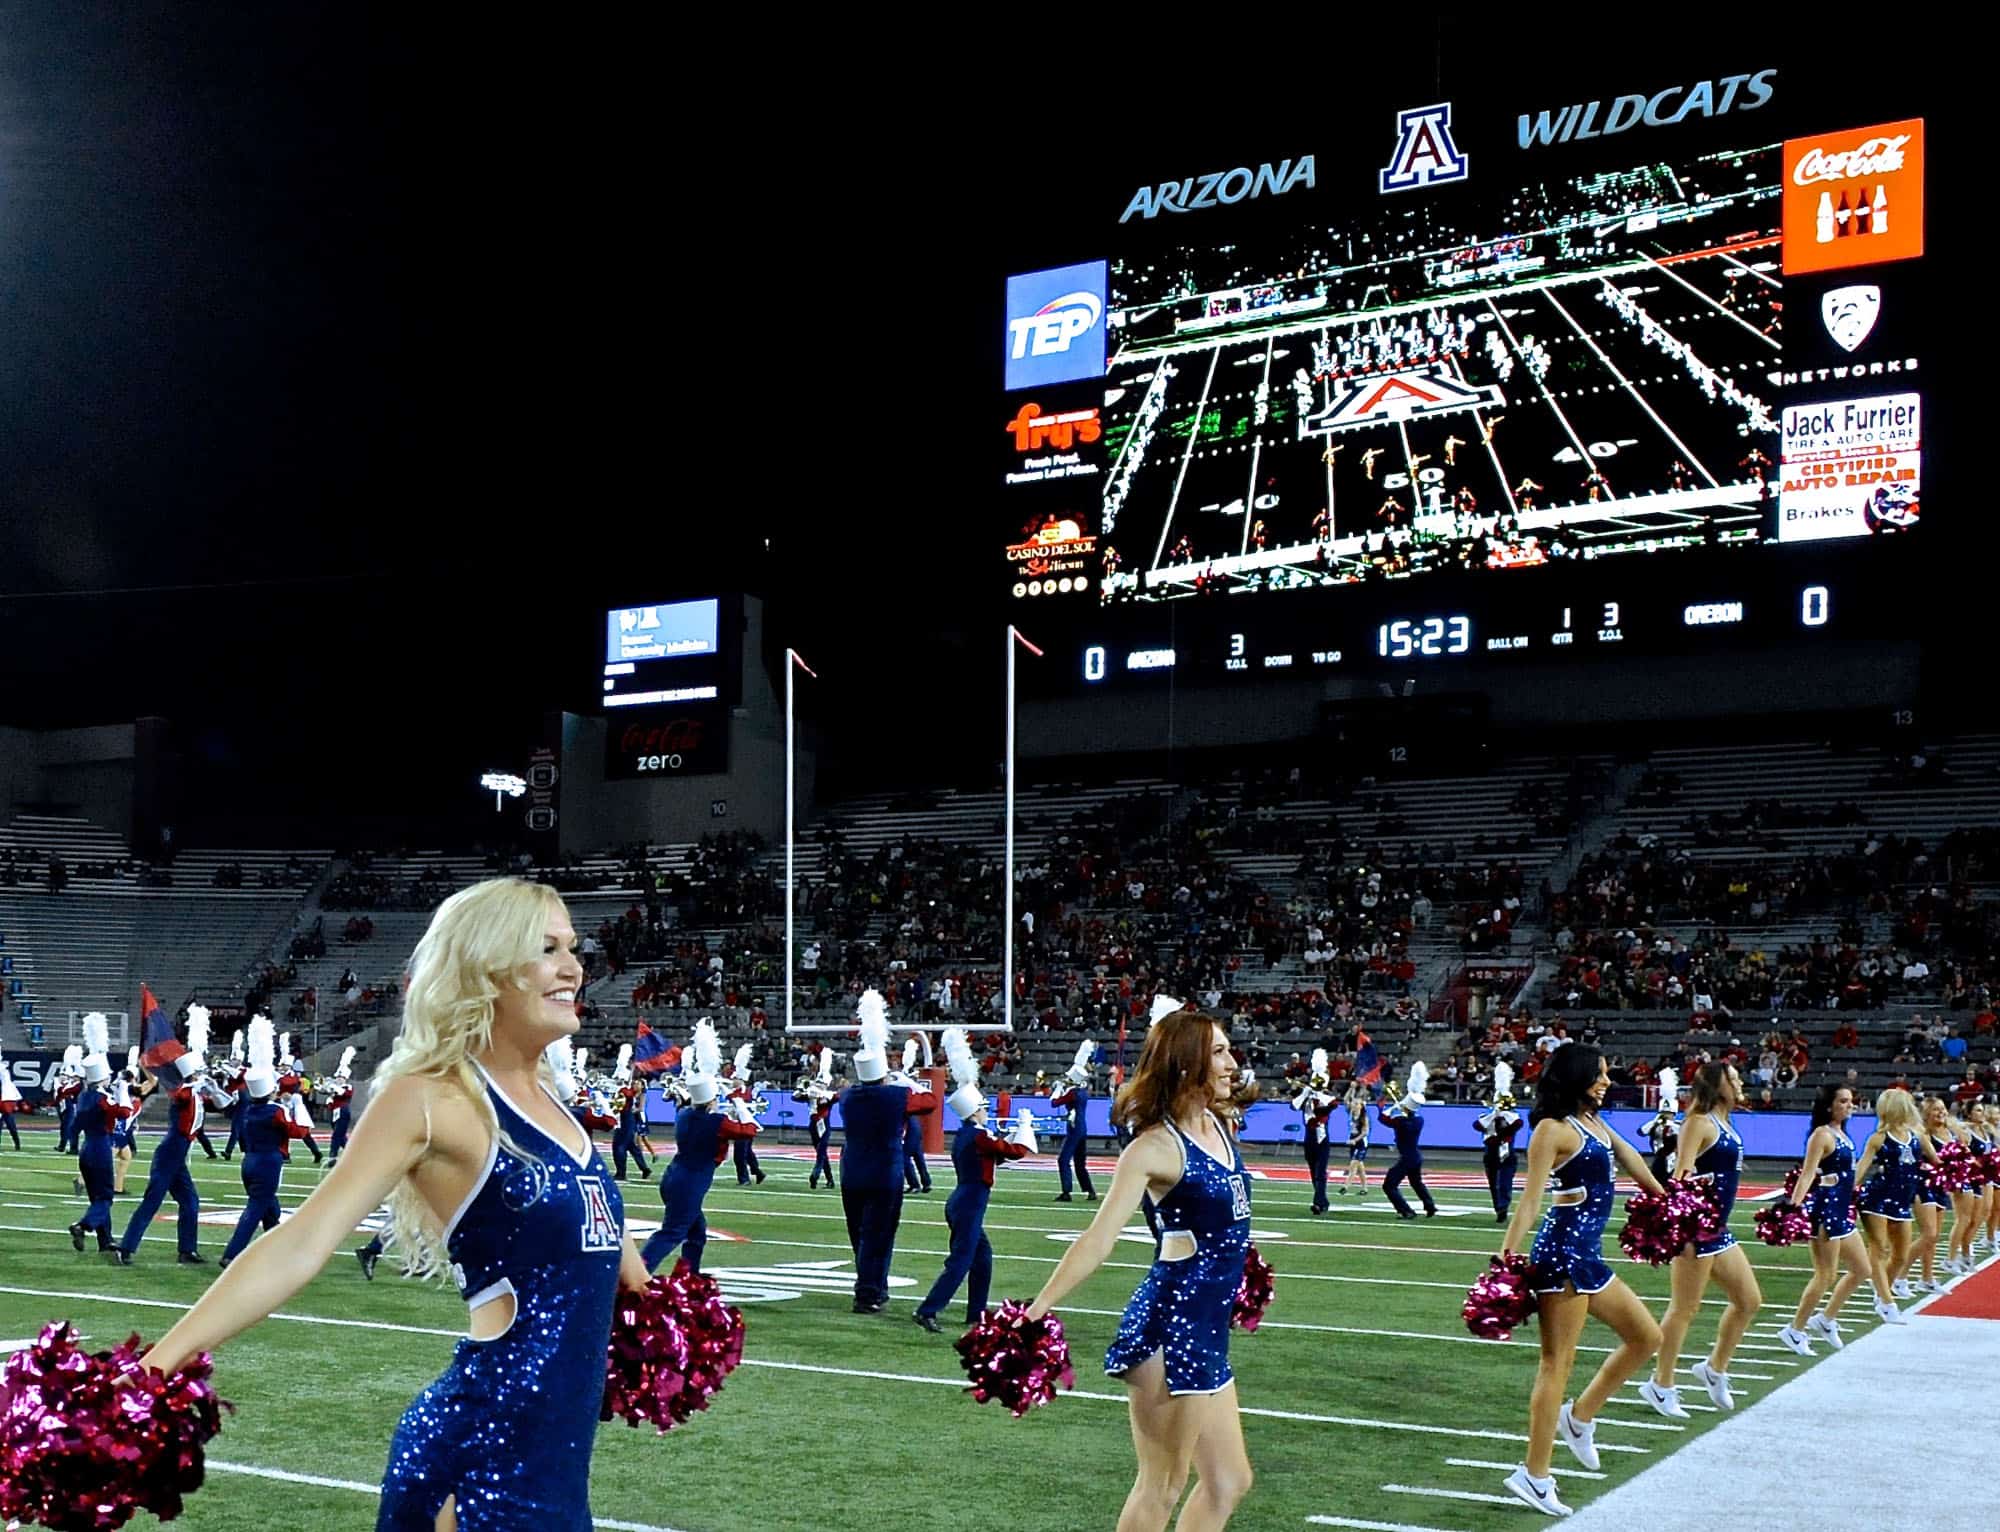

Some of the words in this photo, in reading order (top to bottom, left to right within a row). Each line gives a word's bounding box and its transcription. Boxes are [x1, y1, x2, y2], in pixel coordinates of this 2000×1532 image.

[1518, 68, 1778, 149] WILDCATS
[1379, 102, 1469, 195] A
[1118, 154, 1315, 224] ARIZONA
[1009, 308, 1093, 360] TEP
[1783, 358, 1919, 386] NETWORKS
[1786, 408, 1835, 438] Jack
[1845, 400, 1916, 431] Furrier
[1837, 432, 1874, 445] AUTO
[1801, 457, 1898, 477] CERTIFIED
[1783, 476, 1838, 492] AUTO
[1845, 468, 1916, 486] REPAIR
[1786, 506, 1855, 521] Brakes
[1007, 546, 1050, 561] CASINO
[1051, 545, 1072, 556] DEL
[1073, 542, 1096, 553] SOL
[1604, 602, 1619, 626] 3
[1802, 586, 1828, 625] 0
[1563, 607, 1571, 628] 1
[1231, 634, 1244, 656] 3
[1379, 616, 1470, 657] 15:23
[1487, 638, 1512, 649] BALL
[1085, 647, 1104, 680] 0
[1264, 655, 1292, 667] DOWN
[1327, 651, 1342, 662] GO
[1892, 710, 1913, 725] 13
[637, 753, 682, 772] zero
[1391, 747, 1407, 761] 12
[712, 802, 726, 815] 10
[576, 1175, 622, 1252] A
